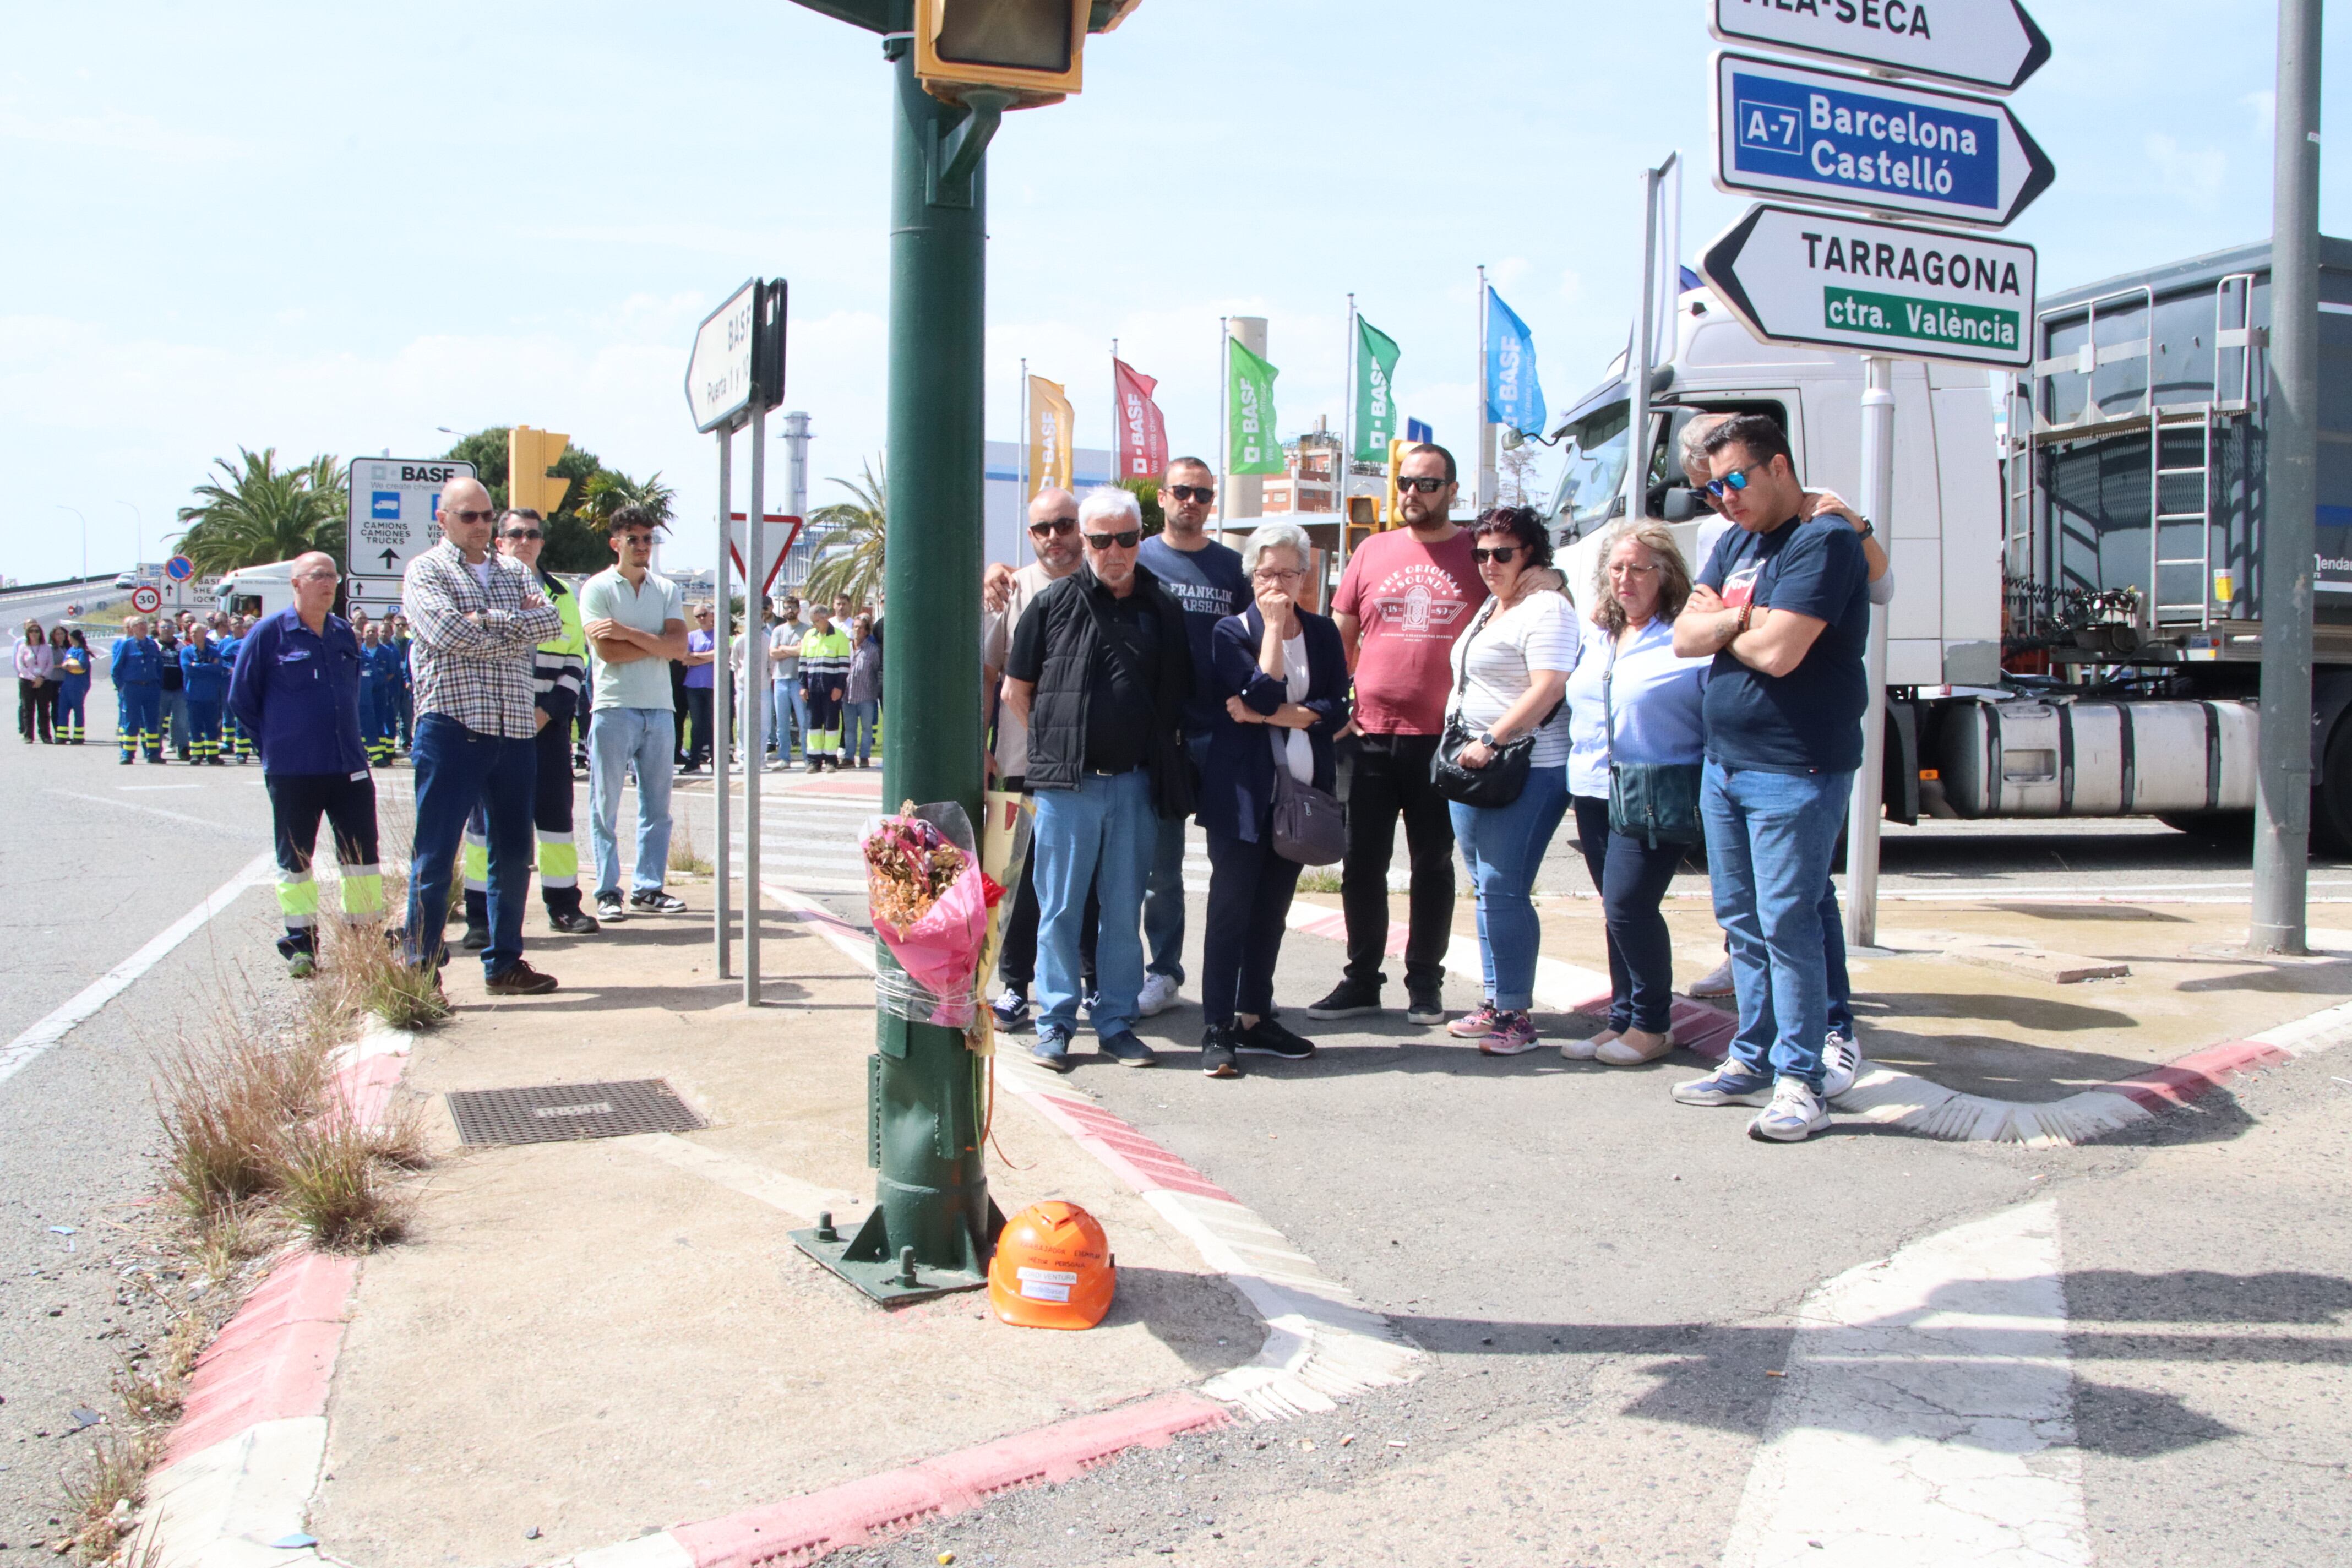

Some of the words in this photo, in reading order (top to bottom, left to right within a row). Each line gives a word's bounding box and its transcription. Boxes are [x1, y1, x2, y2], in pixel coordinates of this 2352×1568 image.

[1746, 110, 1796, 146] A-7
[1810, 94, 1977, 156] Barcelona
[1811, 140, 1952, 195] Castelló
[1801, 232, 2020, 296] TARRAGONA
[728, 304, 751, 352] BASF
[1828, 296, 1892, 331] ctra.
[1906, 303, 2015, 345] València
[1499, 335, 1521, 401] BASF
[1128, 393, 1145, 447] BASF
[1240, 377, 1260, 433] BASF
[1042, 411, 1056, 463] BASF
[401, 466, 454, 482] BASF
[361, 529, 411, 538] CAMIONES
[366, 537, 405, 545] TRUCKS
[138, 595, 156, 605] 30
[1170, 583, 1233, 603] FRANKLIN
[1378, 570, 1402, 593] THE
[1404, 564, 1463, 597] ORIGINAL
[1396, 575, 1444, 590] SOUND
[1044, 1273, 1075, 1281] VENTURA
